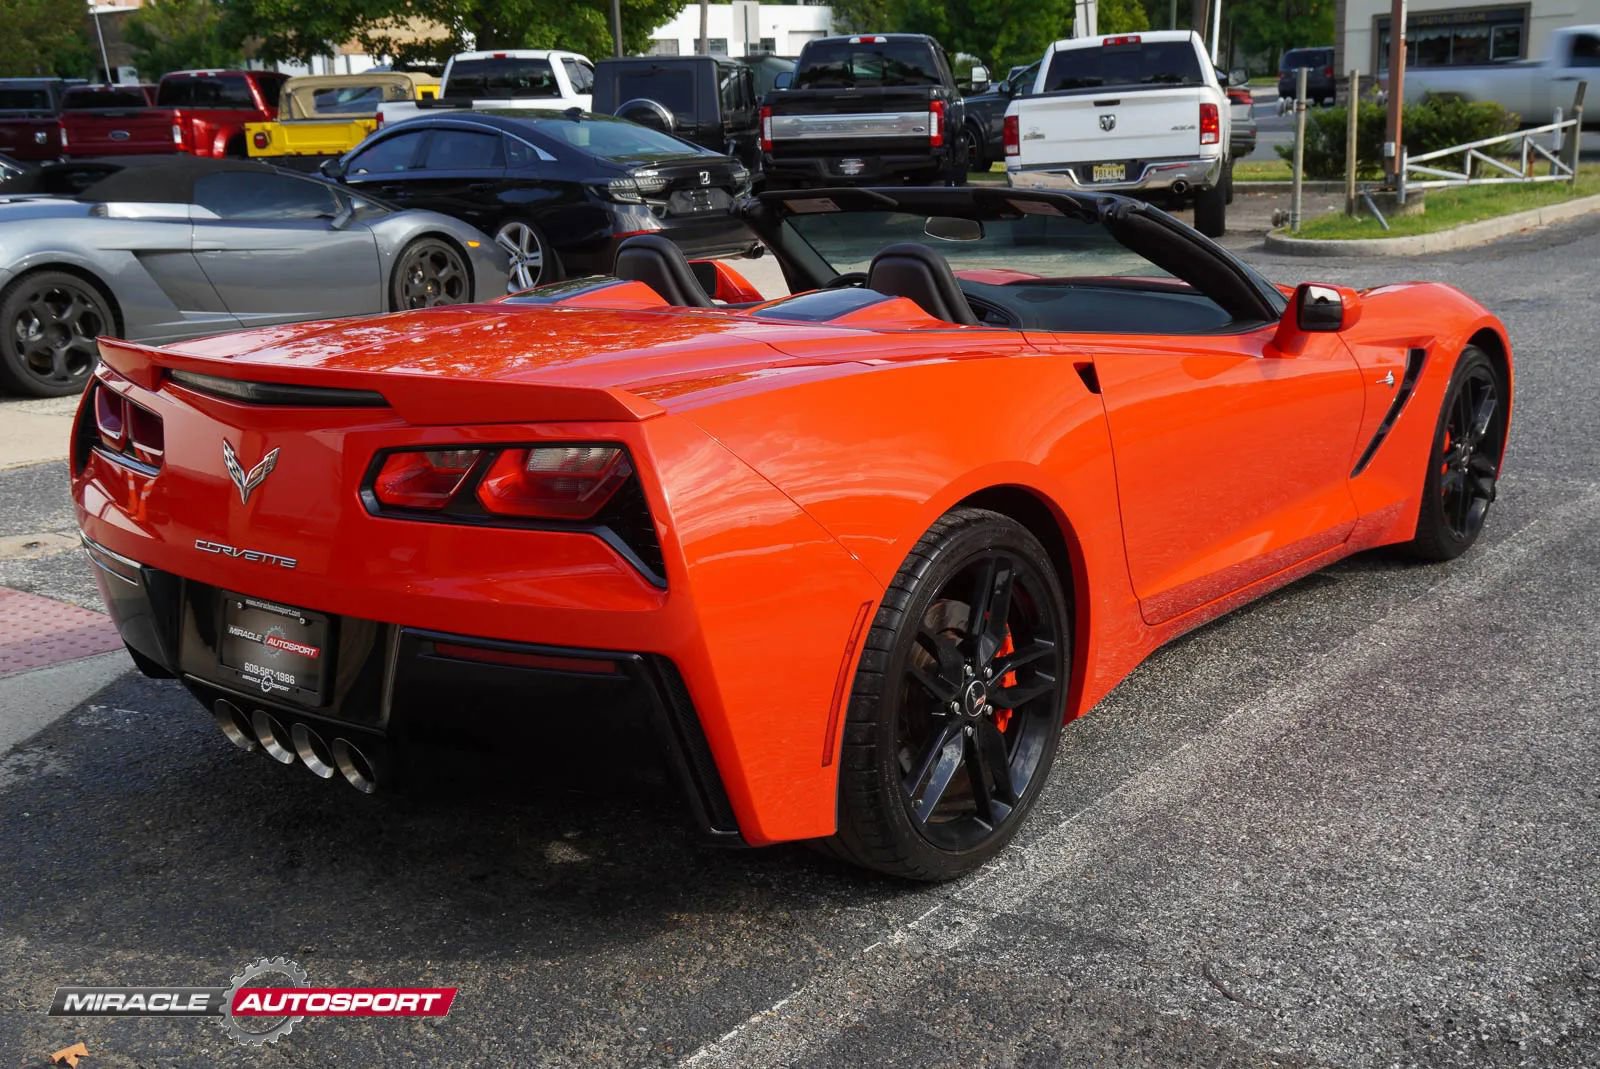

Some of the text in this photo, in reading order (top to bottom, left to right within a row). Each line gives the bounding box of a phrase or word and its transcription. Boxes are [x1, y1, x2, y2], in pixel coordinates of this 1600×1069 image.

[194, 539, 297, 568] CORVETTE
[228, 626, 316, 656] MIRACLE AUTOSPORT
[242, 674, 290, 692] MIRACLE AUTOSPORT
